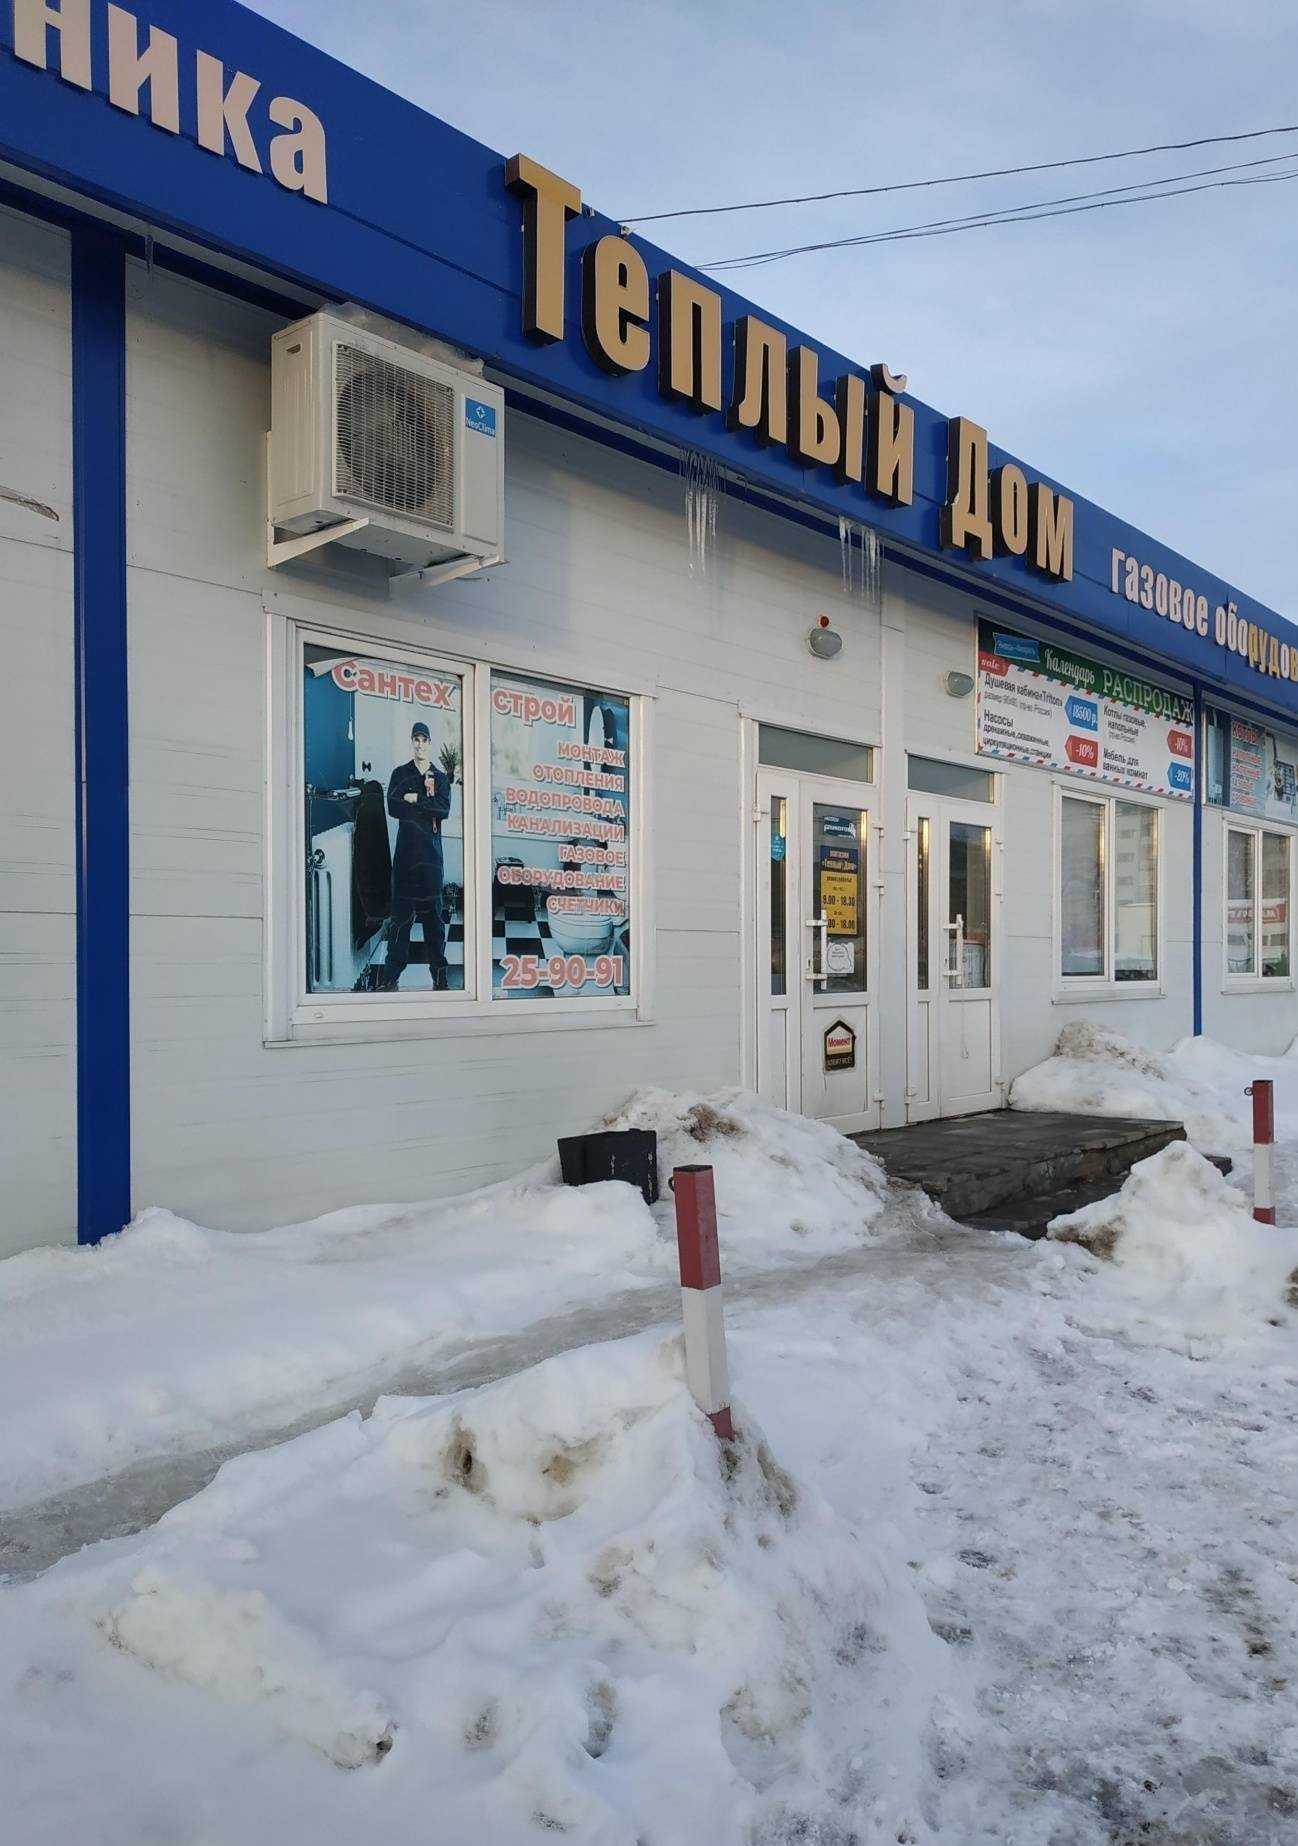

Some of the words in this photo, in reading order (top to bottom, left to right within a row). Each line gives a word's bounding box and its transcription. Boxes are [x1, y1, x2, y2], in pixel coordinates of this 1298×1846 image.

[505, 153, 915, 506] Теплый
[941, 416, 1073, 582] Дом
[465, 417, 496, 437] NeoClima
[1111, 548, 1208, 636] газовое
[1045, 648, 1095, 688] Календарь
[985, 672, 1016, 692] Душевая
[984, 709, 1014, 727] Насосы
[557, 742, 625, 767] МОНТАЖ
[533, 765, 625, 792] ОТОПЛЕНИЯ
[506, 787, 625, 817] ВОДОПРОВОДА
[507, 814, 625, 841] КАНАЛИЗАЦИИ
[558, 845, 625, 866] ГАЗОВОЕ
[498, 866, 625, 890] ОБОРУДОВАНИЕ
[546, 895, 625, 915] СЧЕТЧИКИ
[501, 955, 624, 988] 25-90-91
